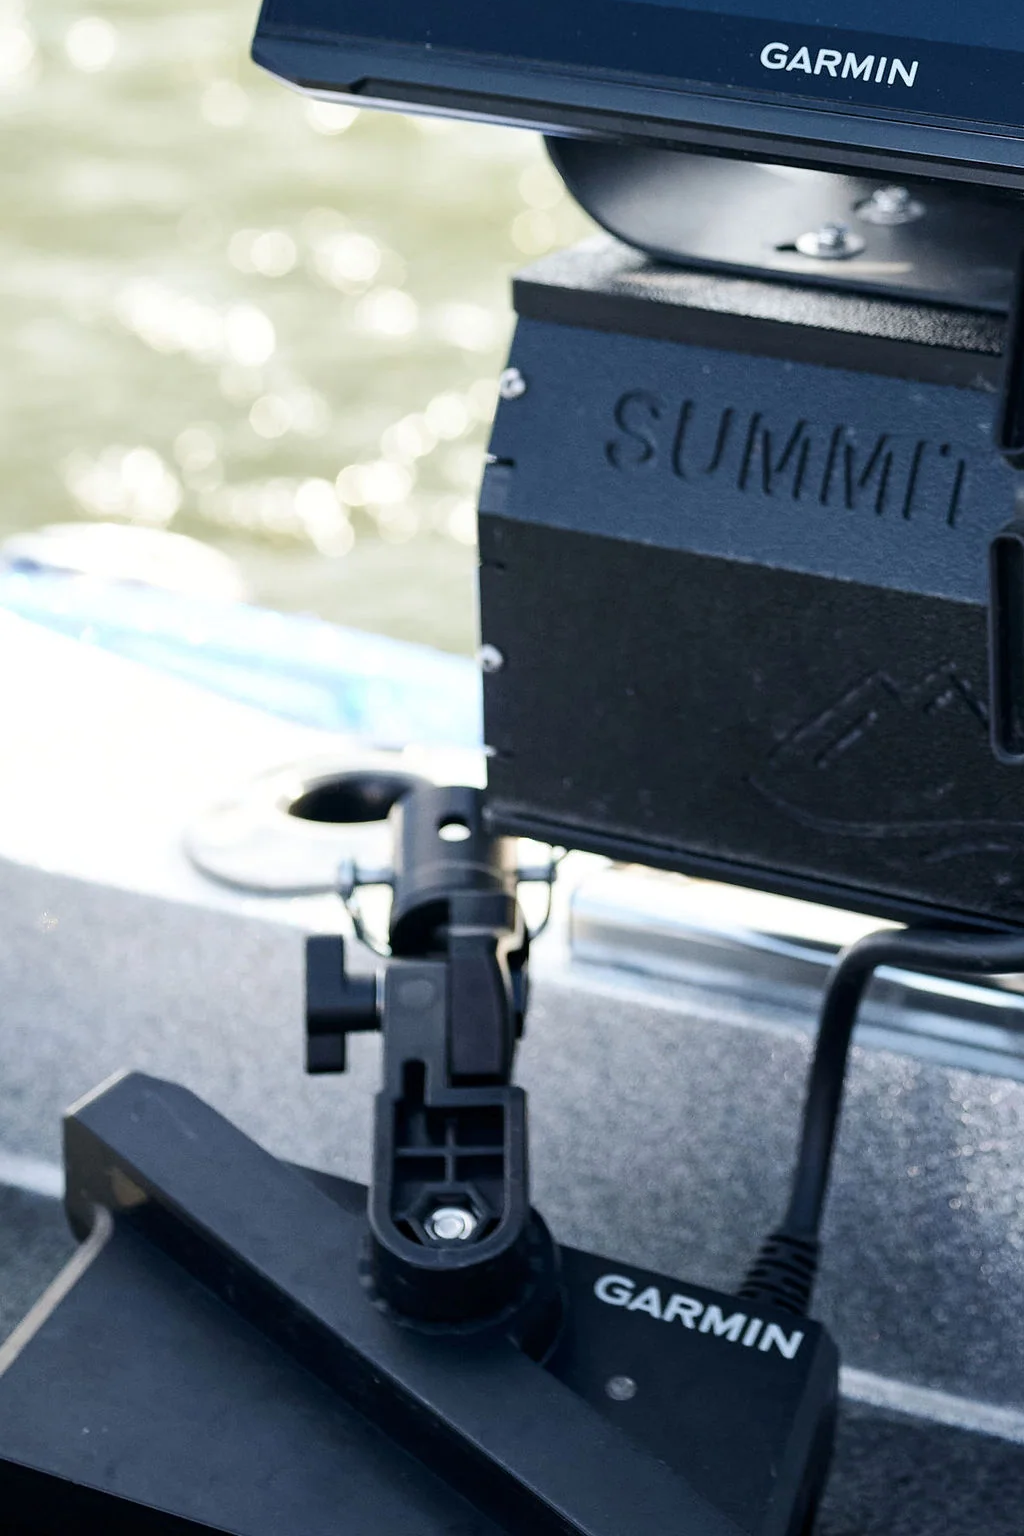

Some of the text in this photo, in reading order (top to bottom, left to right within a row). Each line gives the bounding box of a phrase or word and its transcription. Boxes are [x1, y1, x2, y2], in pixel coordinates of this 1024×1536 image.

[759, 41, 919, 88] GARMIN
[604, 388, 970, 529] SUMMIT
[593, 1273, 805, 1360] GARMIN
